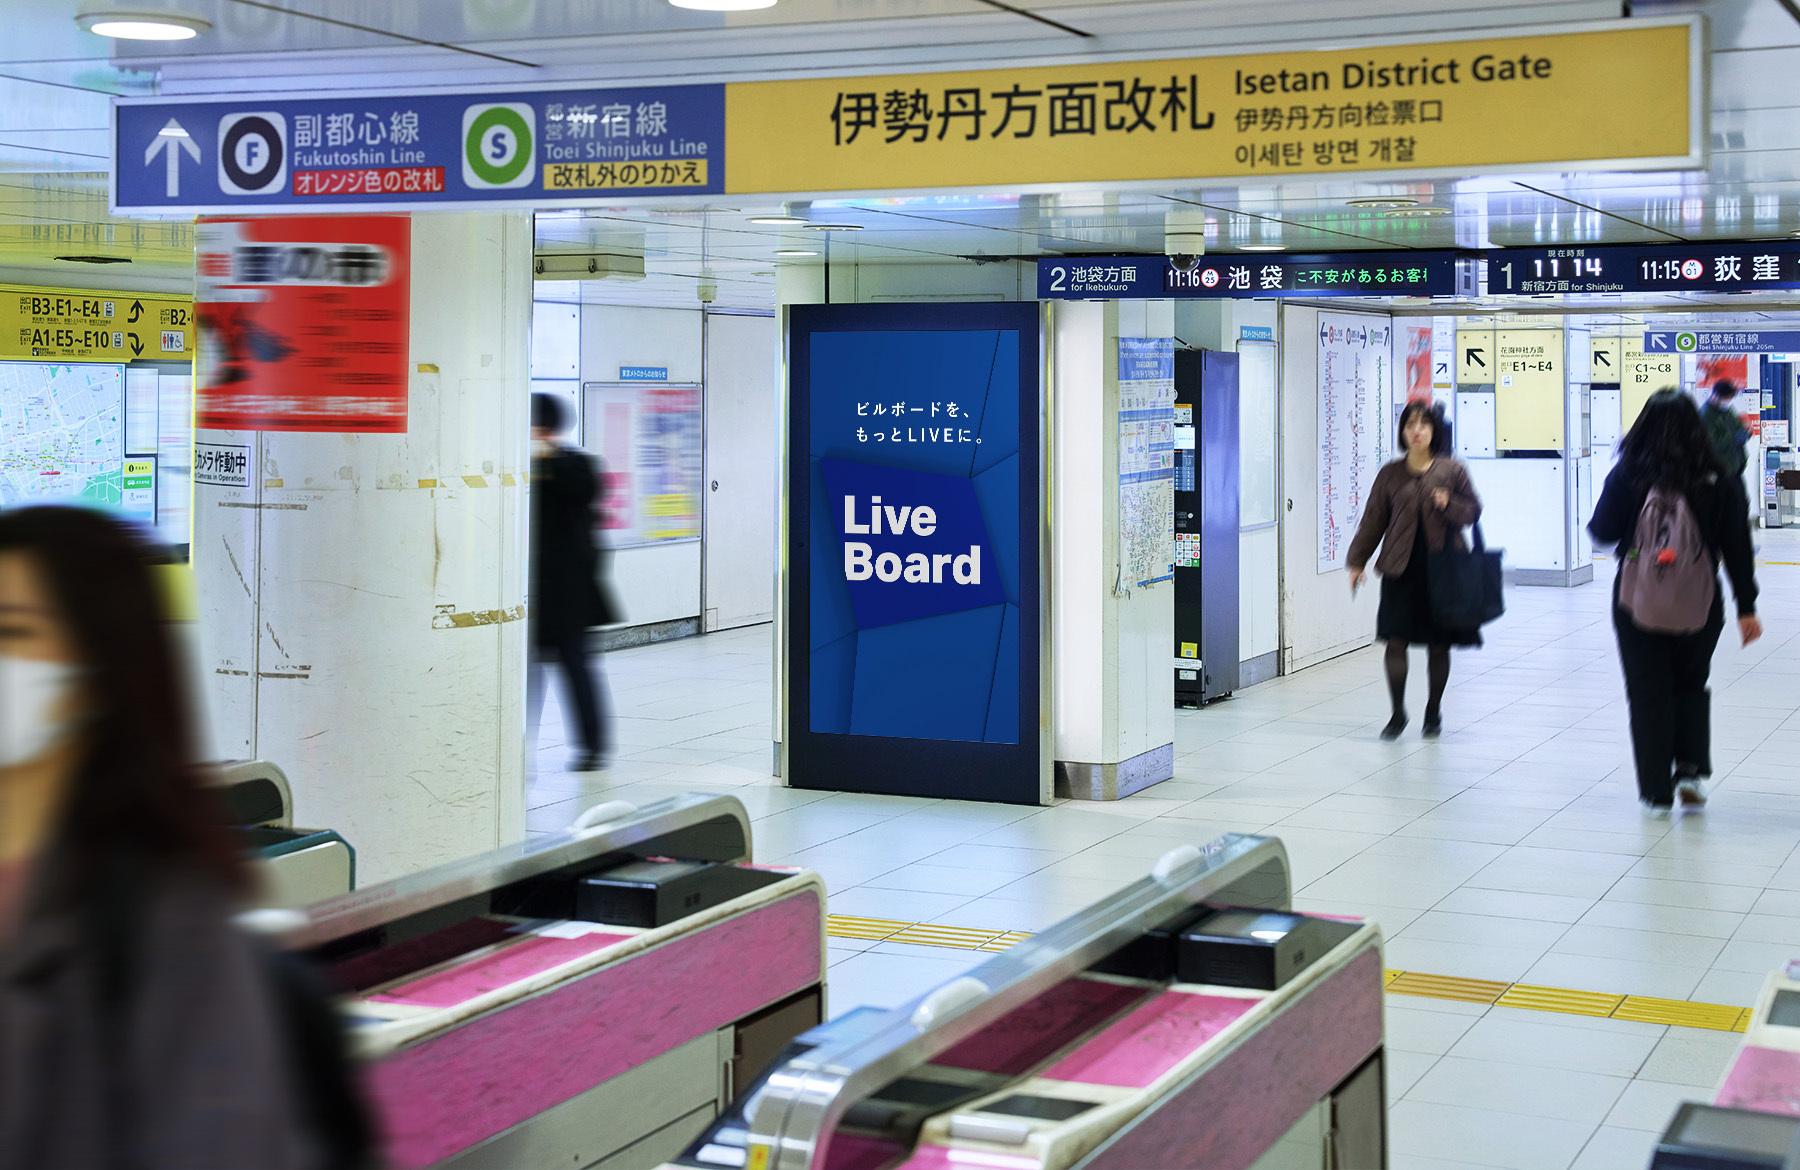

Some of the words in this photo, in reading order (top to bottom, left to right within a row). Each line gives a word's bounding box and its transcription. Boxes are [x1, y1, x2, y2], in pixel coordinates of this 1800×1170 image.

[1235, 69, 1329, 95] Isetan
[1343, 57, 1460, 89] District
[1471, 55, 1553, 82] Gate
[830, 74, 1216, 146] 伊勢丹方面改札
[1235, 100, 1443, 133] 伊势丹方向检票口
[293, 111, 420, 148] 副都心線
[246, 142, 259, 166] F
[293, 147, 386, 167] Fukutoshin
[390, 147, 426, 165] Line
[491, 132, 507, 159] S
[545, 143, 580, 161] Toei
[585, 140, 664, 162] Shinjuku
[669, 138, 708, 157] Line
[1235, 143, 1303, 168] 이세탄
[1313, 139, 1359, 165] 방면
[1369, 137, 1417, 163] 개찰
[296, 169, 443, 193] オレンジ色の改札
[552, 162, 702, 188] 改札外のりかえ
[1548, 249, 1585, 258] 現在時刻
[1050, 267, 1066, 291] 2
[1071, 266, 1136, 283] 池袋方面
[1168, 269, 1200, 287] 11:16
[1501, 262, 1512, 289] 1
[1642, 260, 1680, 280] 11:15
[1085, 284, 1128, 292] Ikebukuro
[1521, 281, 1569, 292] 新宿方面
[1571, 283, 1583, 291] for
[1586, 282, 1623, 292] Shinjuku
[1699, 333, 1759, 344] 都営新宿線
[1635, 374, 1648, 383] B2
[857, 401, 969, 418] ビルボードを、
[857, 427, 982, 445] もっとLIVEに。
[845, 495, 937, 537] Live
[845, 541, 981, 585] Board
